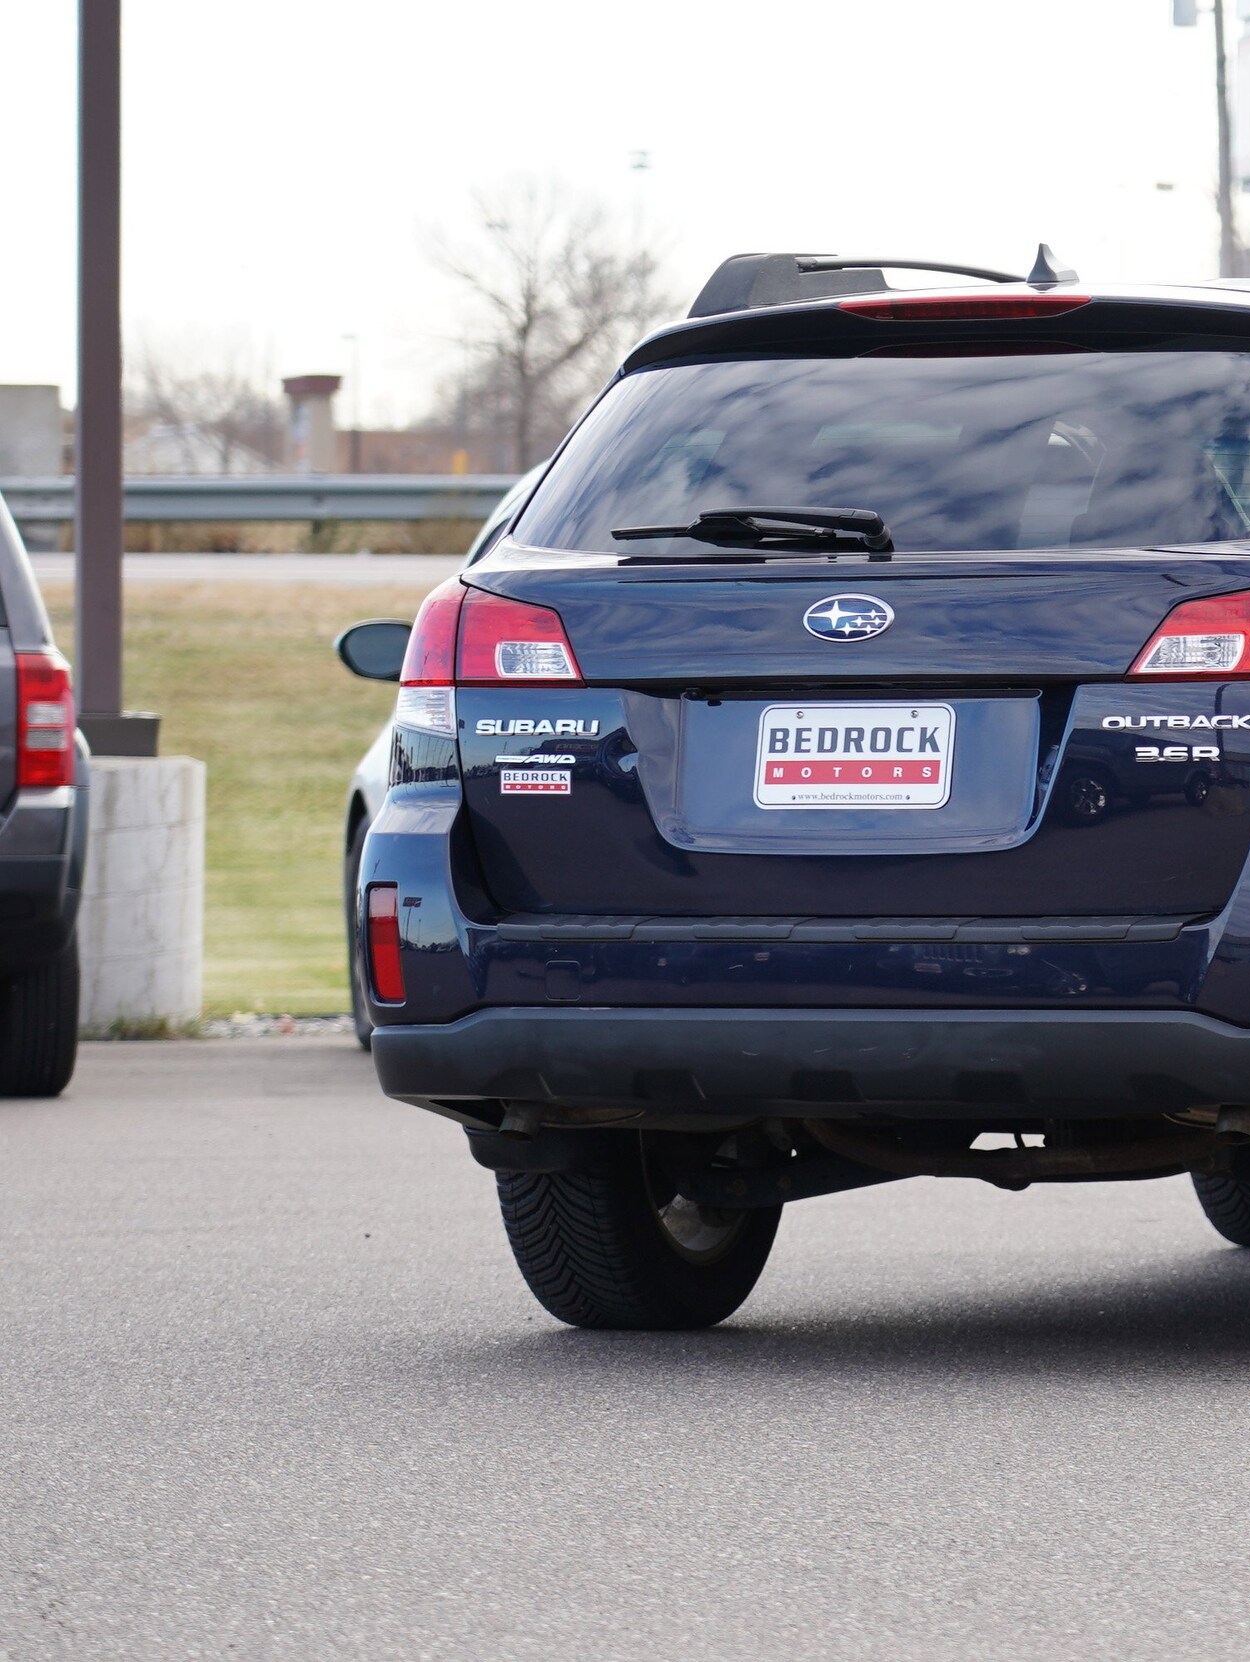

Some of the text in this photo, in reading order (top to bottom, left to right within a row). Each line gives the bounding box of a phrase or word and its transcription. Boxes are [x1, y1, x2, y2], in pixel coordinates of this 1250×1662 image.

[475, 719, 600, 736] SUBARU
[768, 727, 941, 753] BEDROCK
[524, 754, 576, 764] AWD
[1135, 746, 1220, 763] 3.6R
[503, 772, 568, 781] BEDROCK
[773, 767, 933, 778] MOTORS
[797, 792, 903, 801] www.bedrockmotors.com
